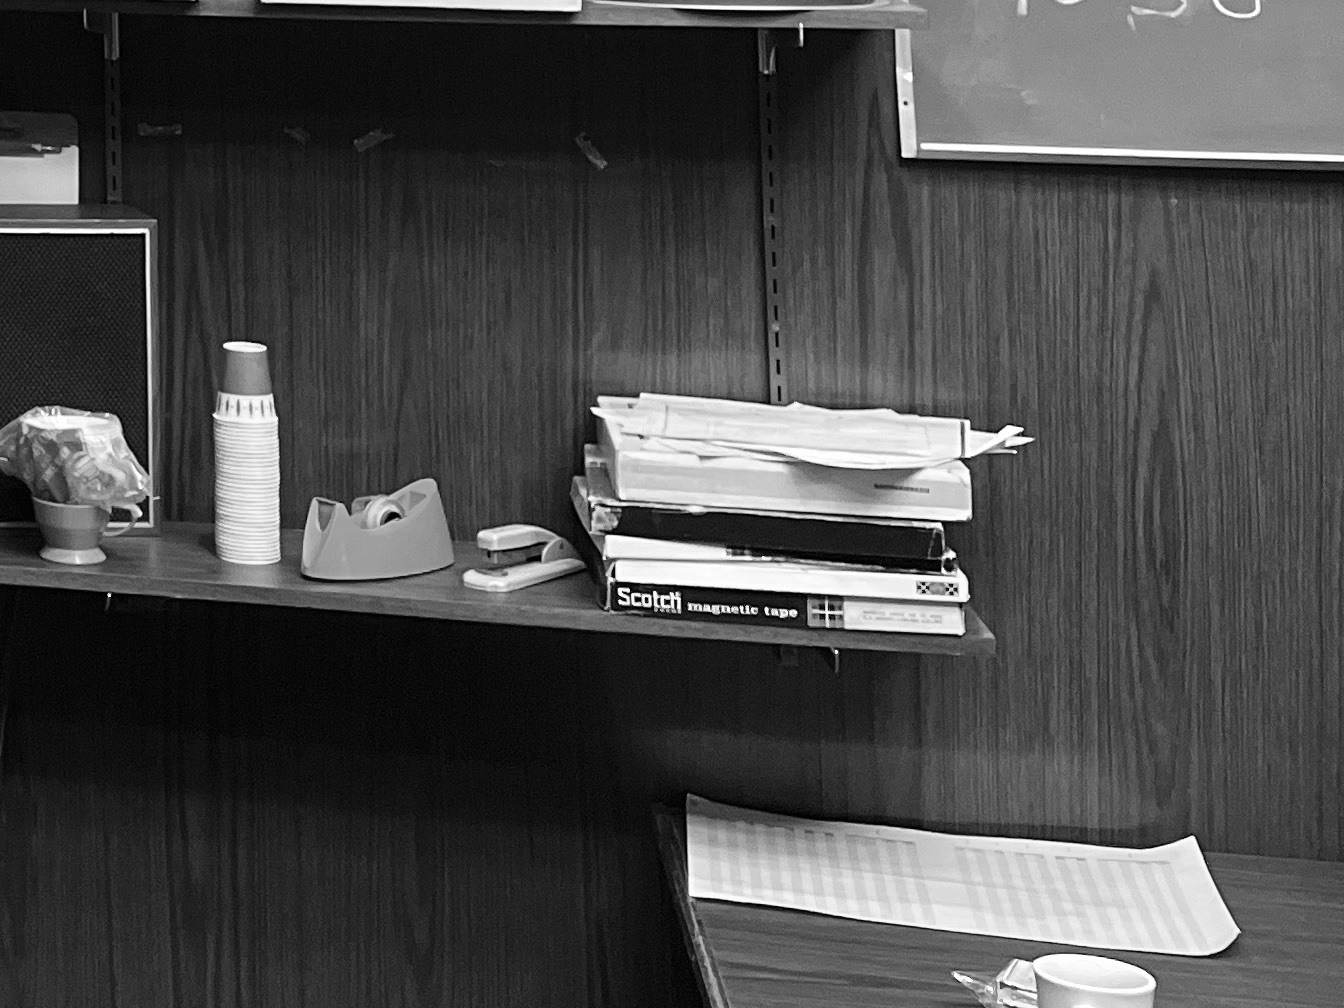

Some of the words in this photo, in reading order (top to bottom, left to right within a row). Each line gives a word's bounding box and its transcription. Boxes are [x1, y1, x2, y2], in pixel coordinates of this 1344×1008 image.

[617, 587, 682, 609] Scotch
[687, 601, 759, 616] magnetic
[764, 606, 799, 620] tape
